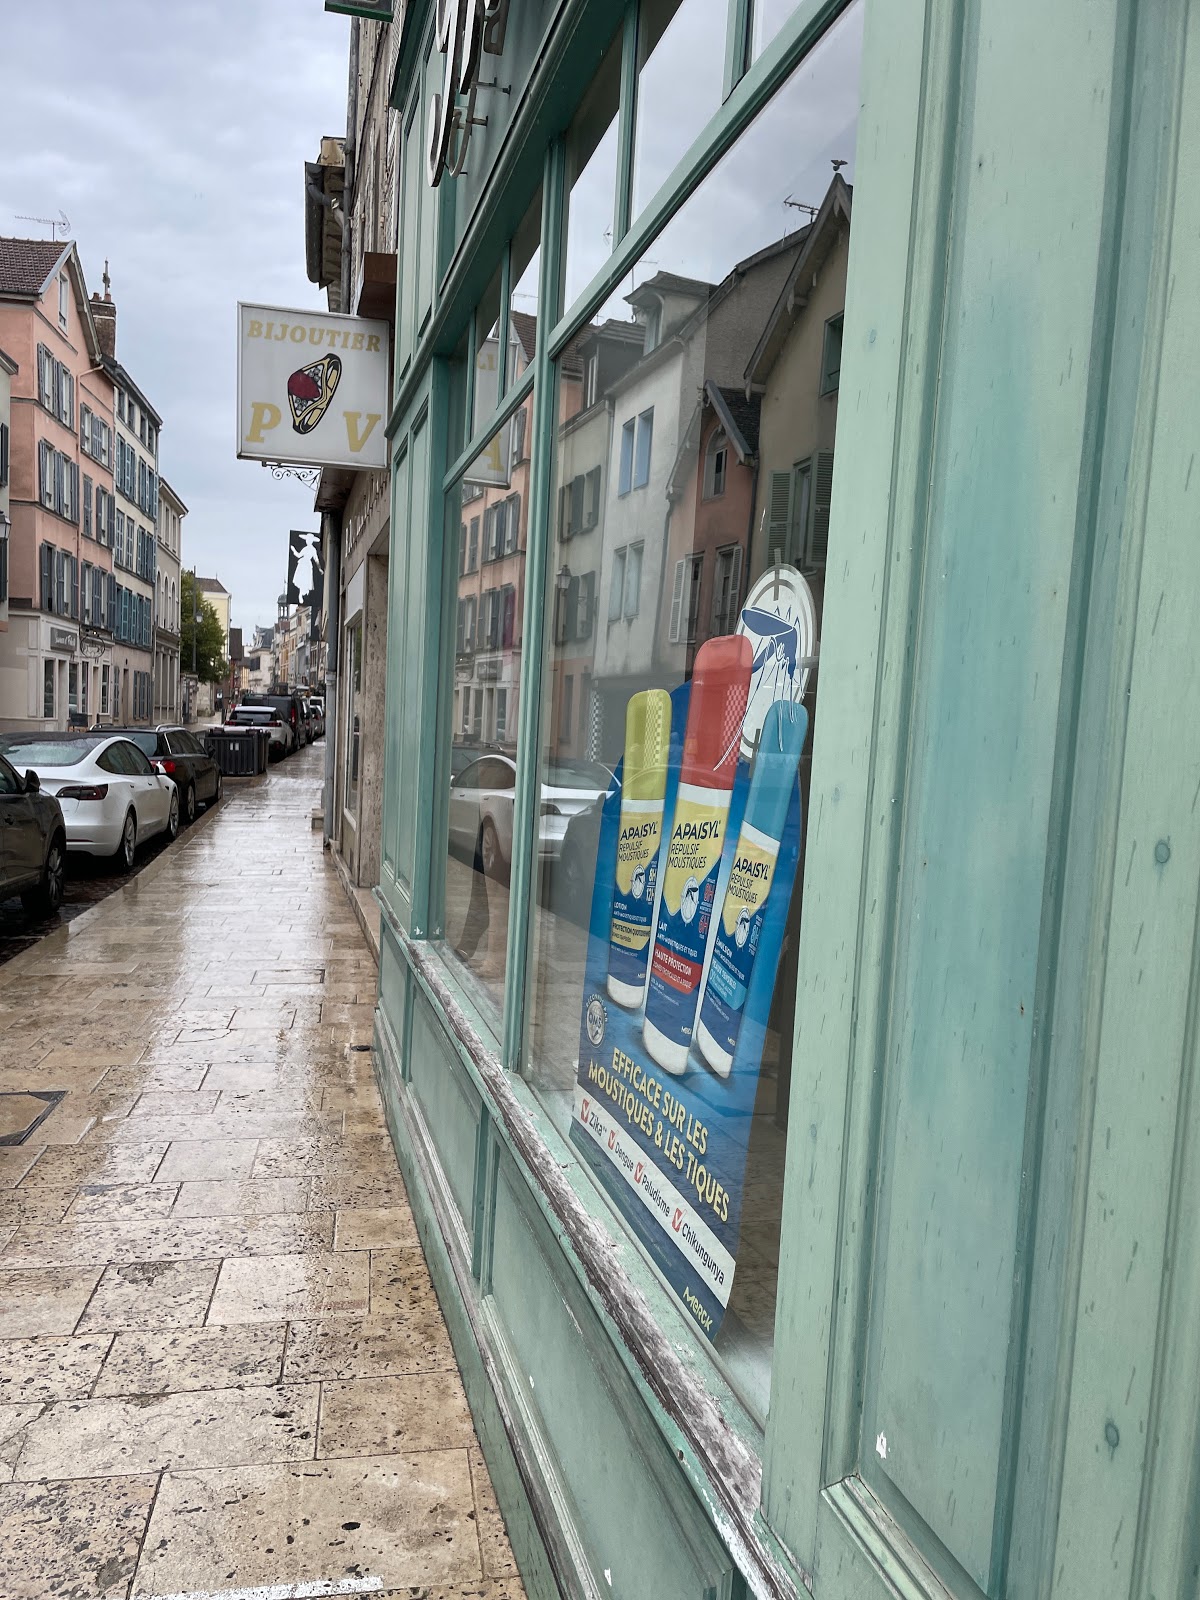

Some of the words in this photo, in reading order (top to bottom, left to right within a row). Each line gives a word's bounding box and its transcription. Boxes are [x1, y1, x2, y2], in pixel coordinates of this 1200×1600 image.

[248, 320, 382, 352] BIJOUTIER
[245, 402, 282, 443] P
[343, 411, 381, 452] V
[620, 821, 658, 841] APAISYL
[673, 820, 719, 840] APAISYL
[618, 848, 649, 862] MOUSTIQUES
[668, 856, 707, 869] MOUSTIQUES
[733, 857, 768, 880] APAISYL
[728, 884, 758, 904] MOUSTIQUES
[667, 956, 692, 976] PROTECTION
[612, 1047, 663, 1109] EFFICACE
[662, 1091, 686, 1133] SUR
[686, 1113, 708, 1155] LES
[588, 1059, 655, 1137] MOUSTIQUES
[654, 1120, 663, 1148] &
[663, 1130, 685, 1170] LES
[686, 1151, 730, 1222] TIQUES
[615, 1142, 634, 1172] Dengue
[641, 1174, 671, 1217] Paludisme
[681, 1223, 725, 1286] Chikungunya
